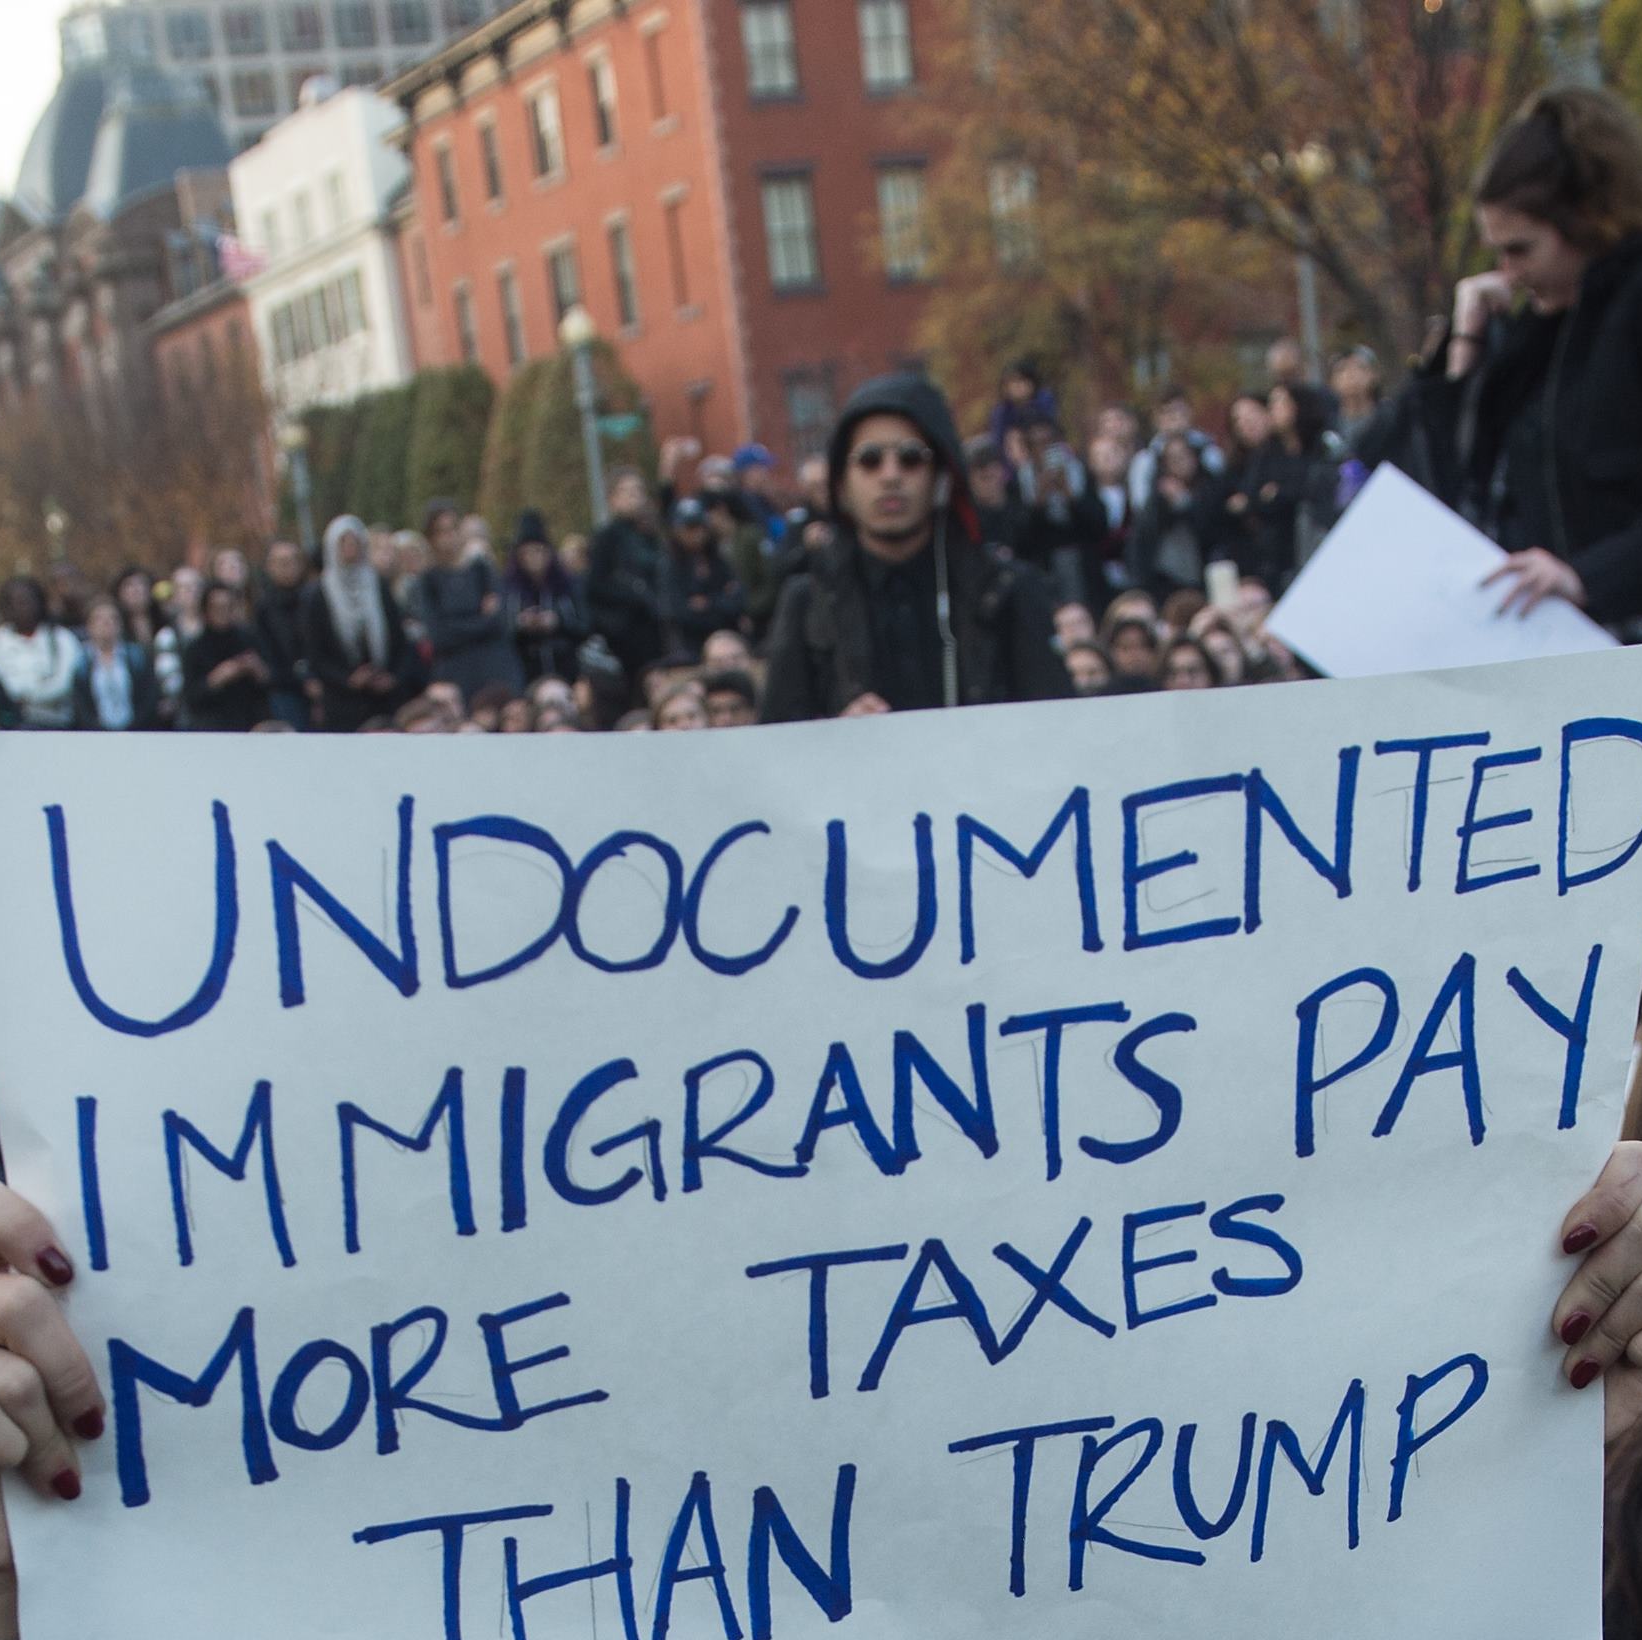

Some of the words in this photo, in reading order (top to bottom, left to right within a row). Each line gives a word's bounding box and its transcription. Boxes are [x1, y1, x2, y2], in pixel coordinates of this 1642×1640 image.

[75, 1001, 1198, 1272] IMMIGRANTS
[1294, 943, 1603, 1157] PAY
[107, 1292, 612, 1508] MORE
[747, 1192, 1303, 1400] TAXES
[948, 1353, 1489, 1597] TRUMP
